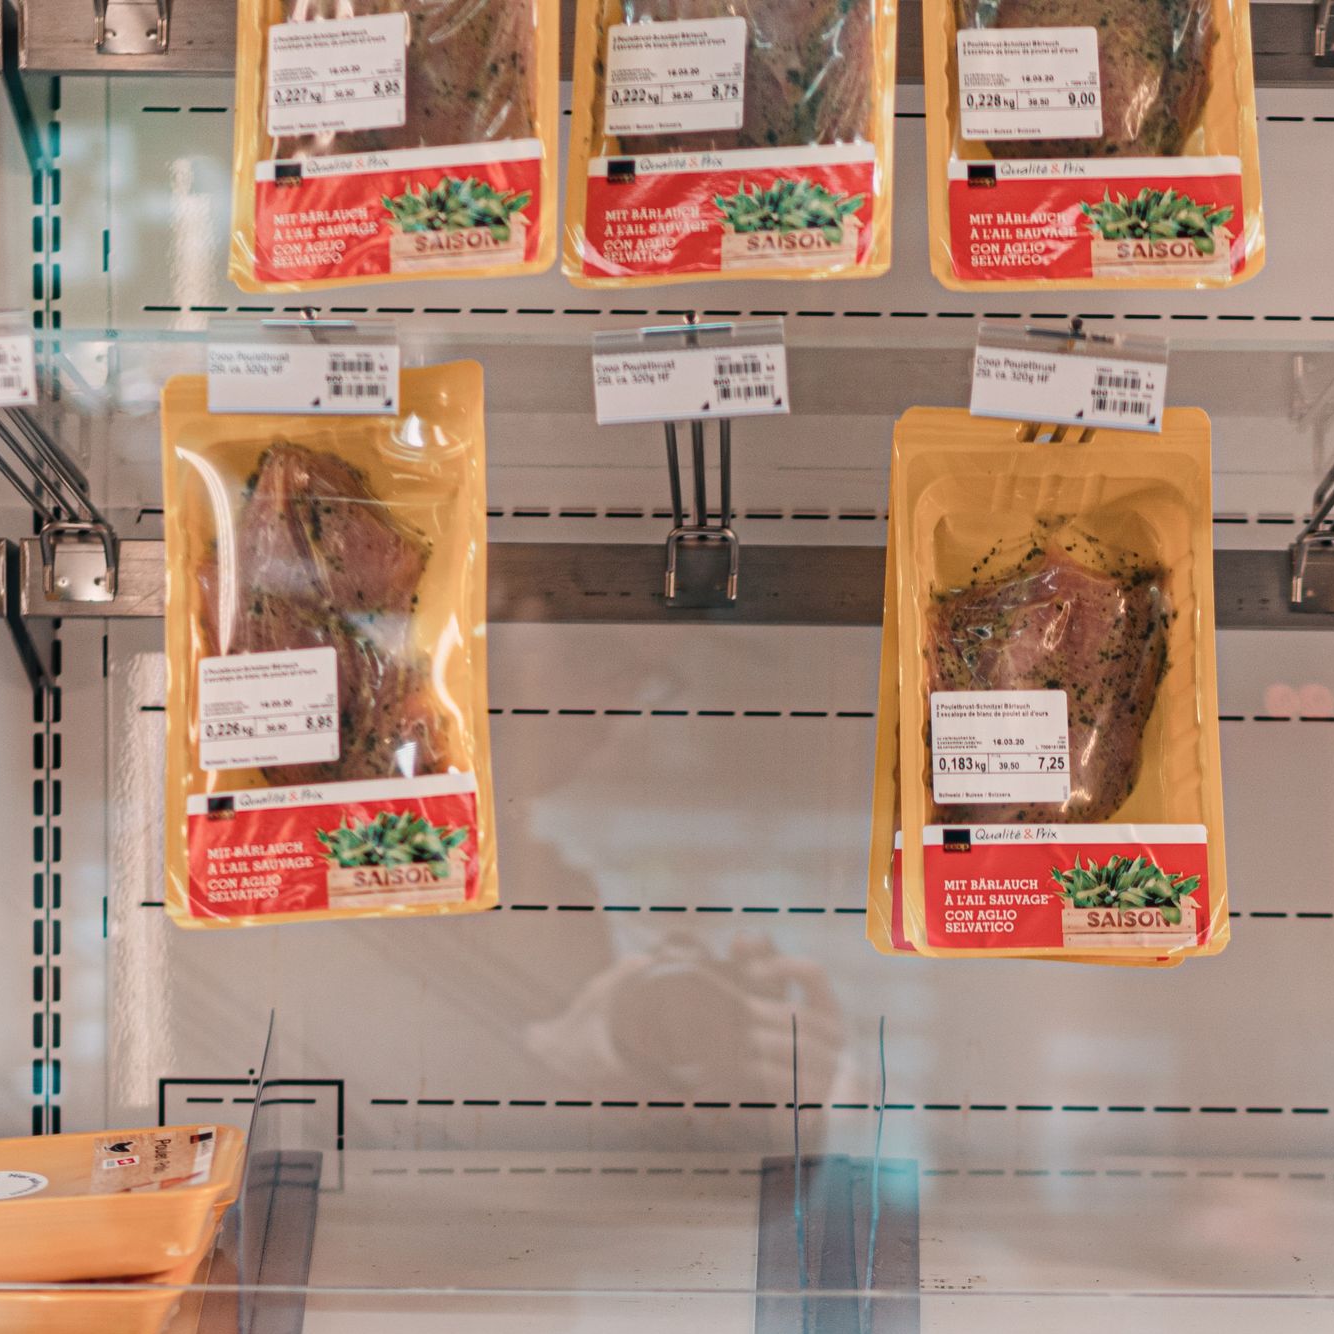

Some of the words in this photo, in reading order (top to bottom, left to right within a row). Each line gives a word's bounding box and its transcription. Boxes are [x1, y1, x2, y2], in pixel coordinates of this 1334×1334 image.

[966, 94, 1001, 109] 0,228
[1068, 92, 1096, 108] 9,00
[605, 210, 630, 221] MIT
[970, 214, 993, 225] MIT
[997, 212, 1065, 224] BÄRLAUCH
[1016, 226, 1077, 238] SAUVAGE
[414, 231, 500, 252] SAISON
[747, 231, 834, 250] SAISON
[970, 243, 1000, 254] CON
[1004, 242, 1045, 253] AGLIO
[1117, 241, 1204, 258] SAISON
[970, 254, 1042, 267] SELVATICO
[939, 757, 973, 772] 0,183
[975, 761, 986, 772] kg
[1038, 757, 1065, 771] 7,25
[975, 826, 1021, 841] Qualité
[1023, 828, 1033, 839] &
[1035, 827, 1058, 840] Prix
[208, 877, 238, 889] CON
[352, 867, 438, 887] SAISON
[944, 879, 969, 890] MIT
[971, 876, 1039, 890] BÄRLAUCH
[945, 892, 954, 906] À
[989, 893, 1049, 905] SAUVAGE
[945, 910, 974, 922] CON
[977, 909, 1017, 922] AGLIO
[1087, 910, 1171, 928] SAISON
[945, 921, 1015, 933] SELVATICO
